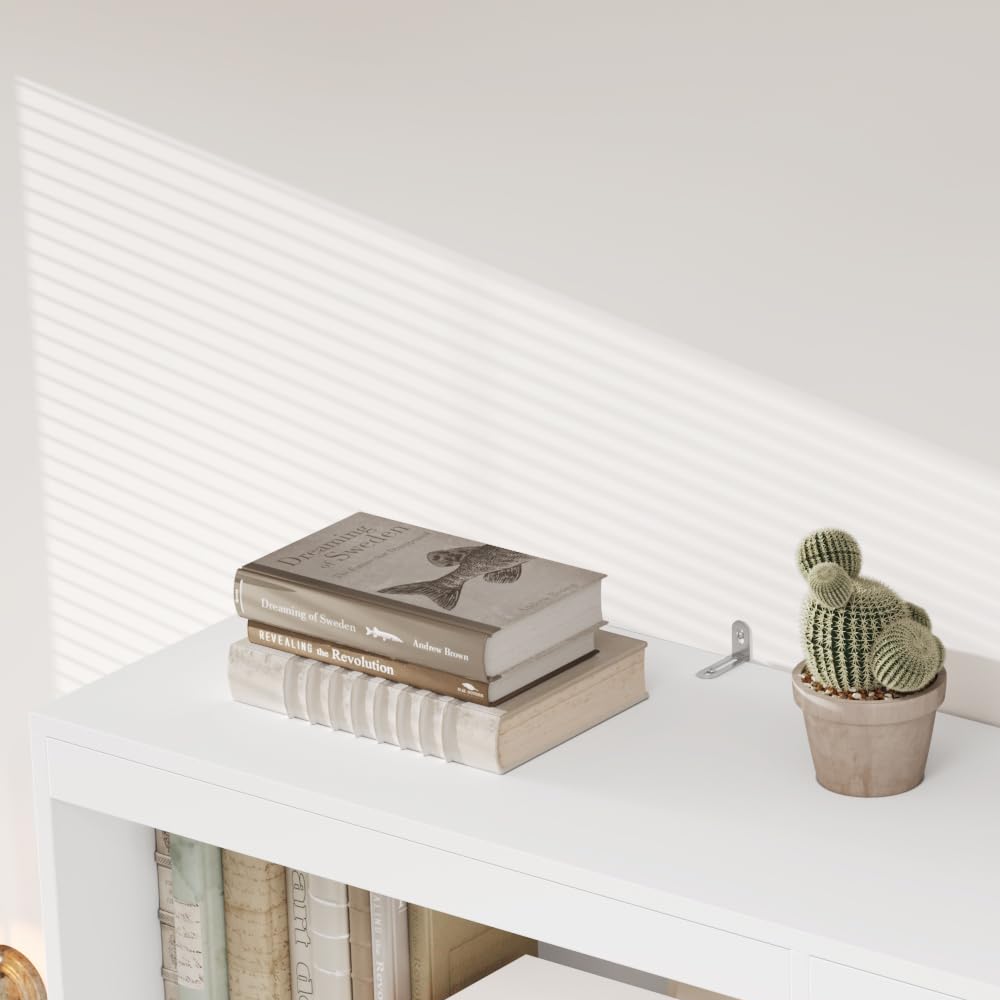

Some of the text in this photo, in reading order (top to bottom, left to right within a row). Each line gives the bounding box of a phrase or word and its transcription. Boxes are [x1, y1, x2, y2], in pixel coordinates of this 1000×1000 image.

[278, 525, 377, 567] Dreaming
[324, 525, 409, 562] Sweden
[261, 598, 469, 661] Dreaming of Sweden Andrew Brown
[259, 630, 395, 676] REVEALING the Revolution
